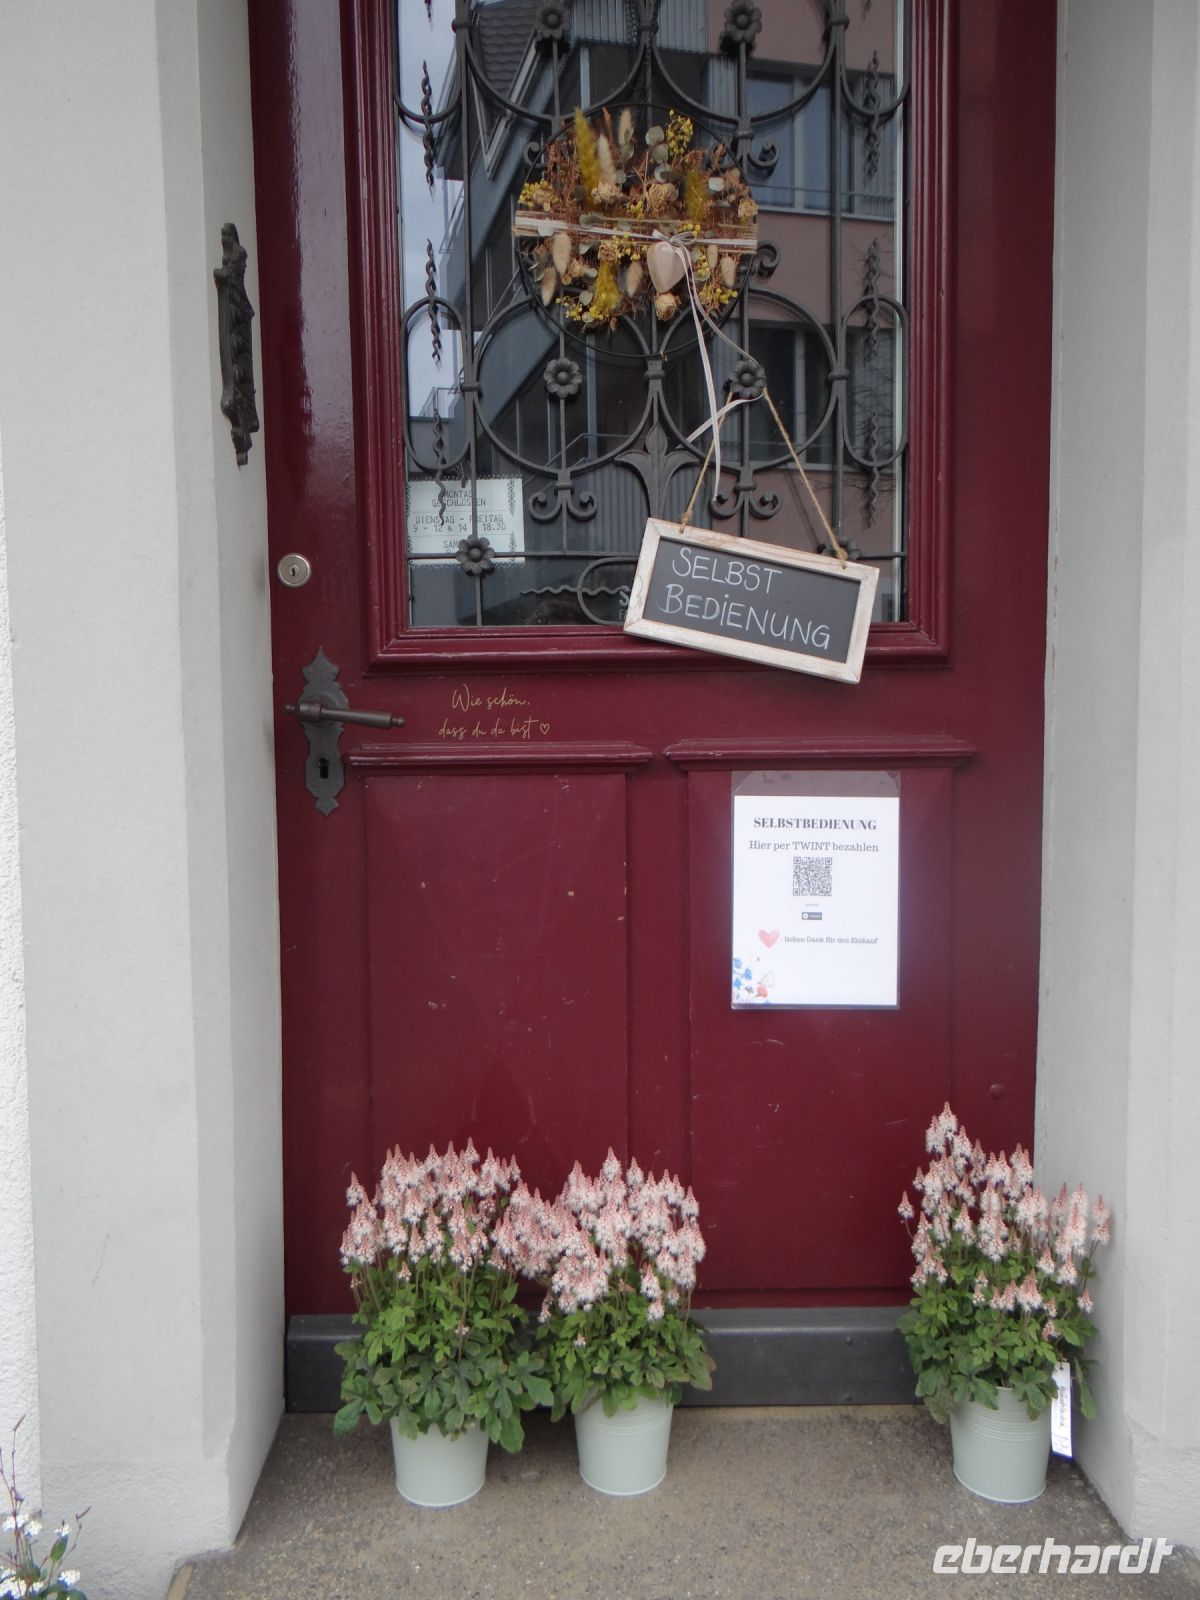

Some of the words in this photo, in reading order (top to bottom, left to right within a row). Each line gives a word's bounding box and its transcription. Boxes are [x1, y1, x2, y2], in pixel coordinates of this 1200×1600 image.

[431, 498, 486, 507] GECHLOSEN
[415, 515, 455, 525] DIENSAG
[469, 514, 504, 523] FEITAG
[671, 547, 783, 594] SELBST
[452, 683, 482, 712] Wie
[438, 718, 468, 740] dass
[471, 721, 487, 738] du
[510, 715, 539, 739] bist
[753, 817, 877, 830] SELBSTBEDIENUNG
[749, 840, 772, 850] Hier
[773, 842, 790, 852] per
[792, 841, 831, 851] TWINT
[832, 842, 879, 852] bezahlen
